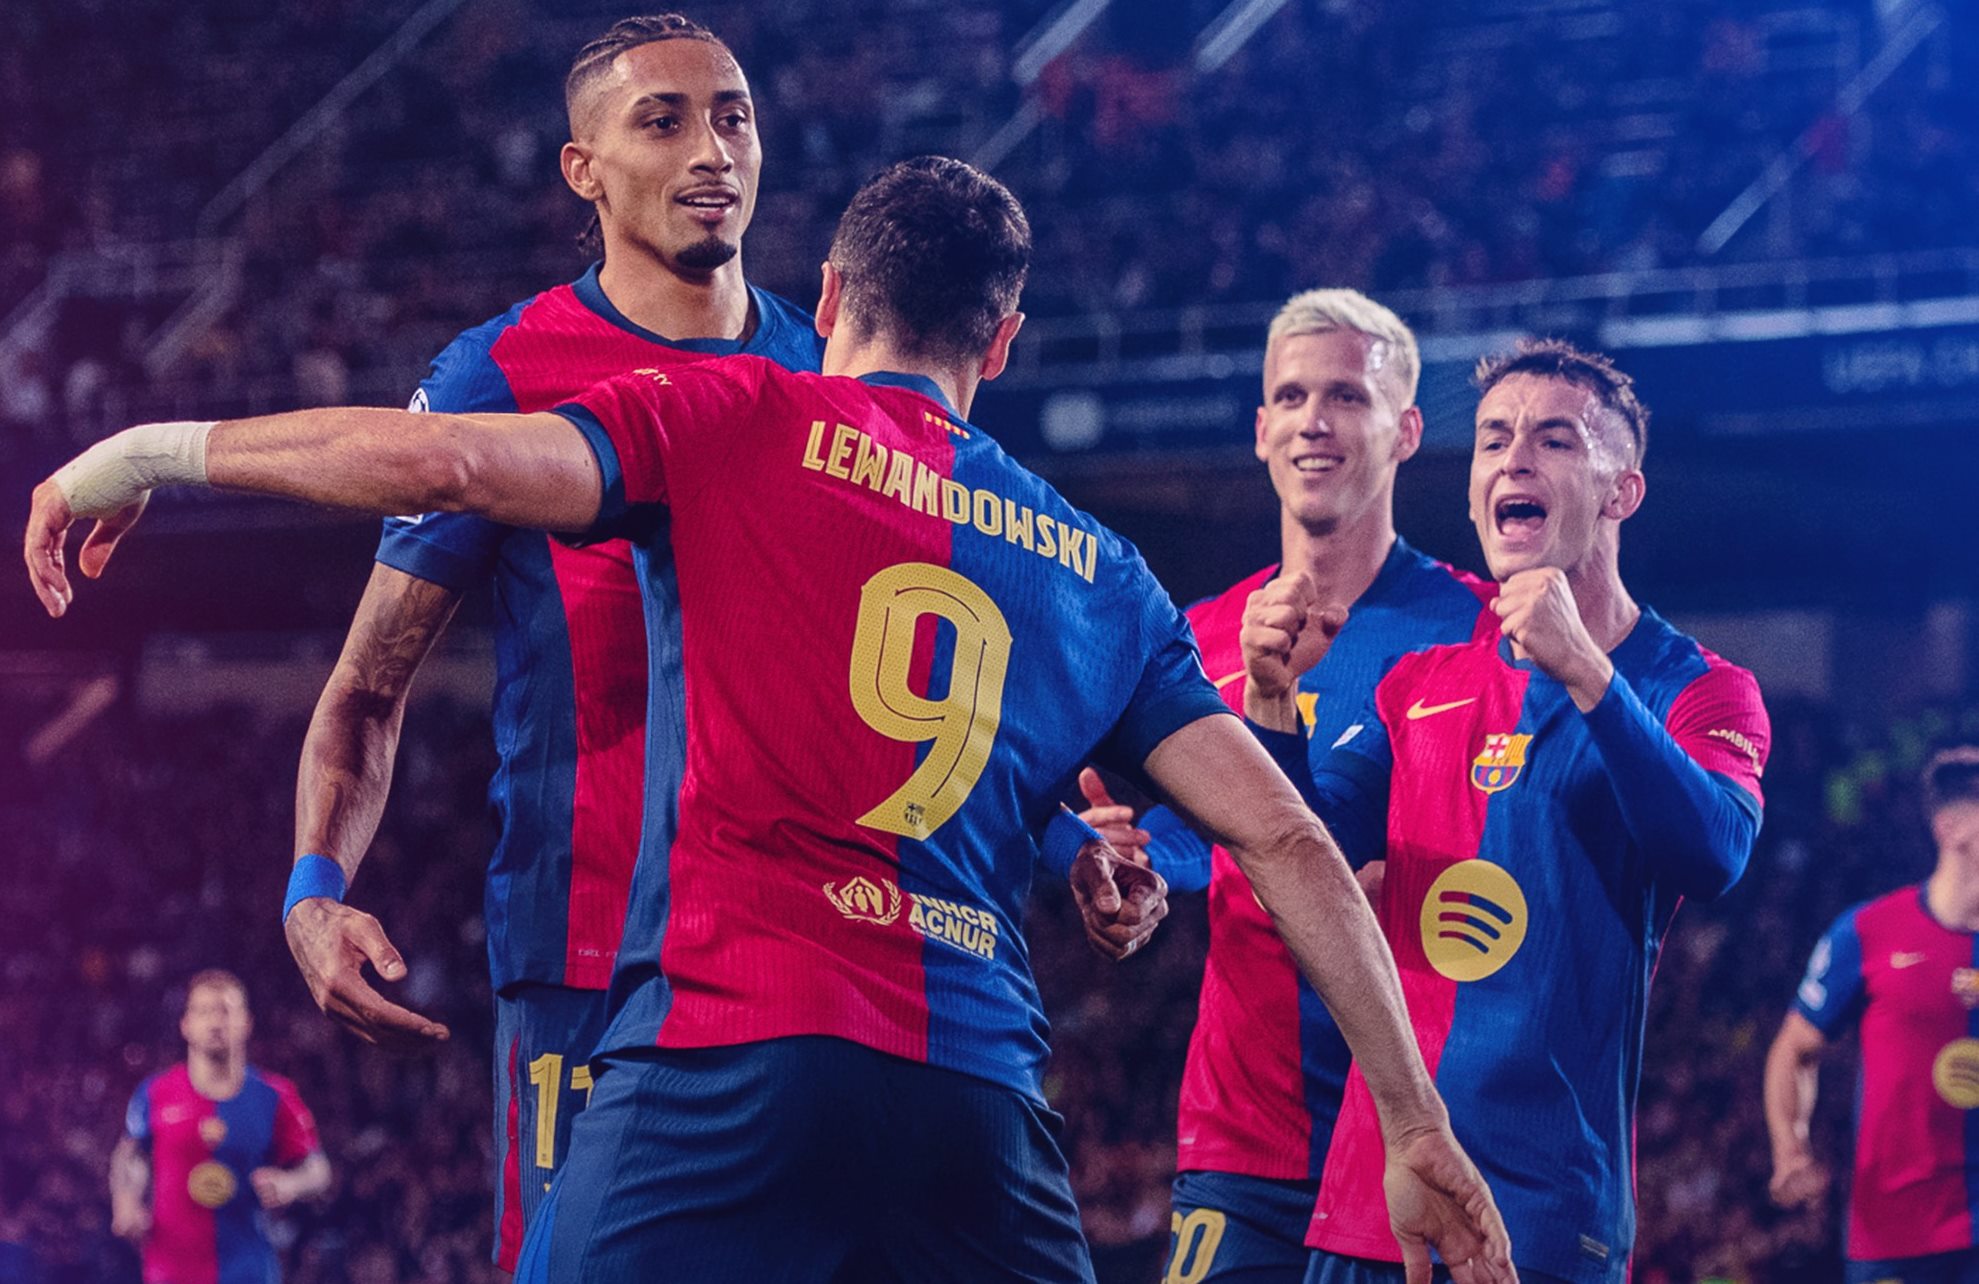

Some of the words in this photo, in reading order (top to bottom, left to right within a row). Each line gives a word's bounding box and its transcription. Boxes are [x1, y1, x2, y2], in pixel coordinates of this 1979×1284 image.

[801, 420, 1098, 584] LEWANDOWSKI
[850, 562, 1013, 842] 9
[908, 902, 997, 961] ACNUR
[1161, 1207, 1226, 1284] 0
